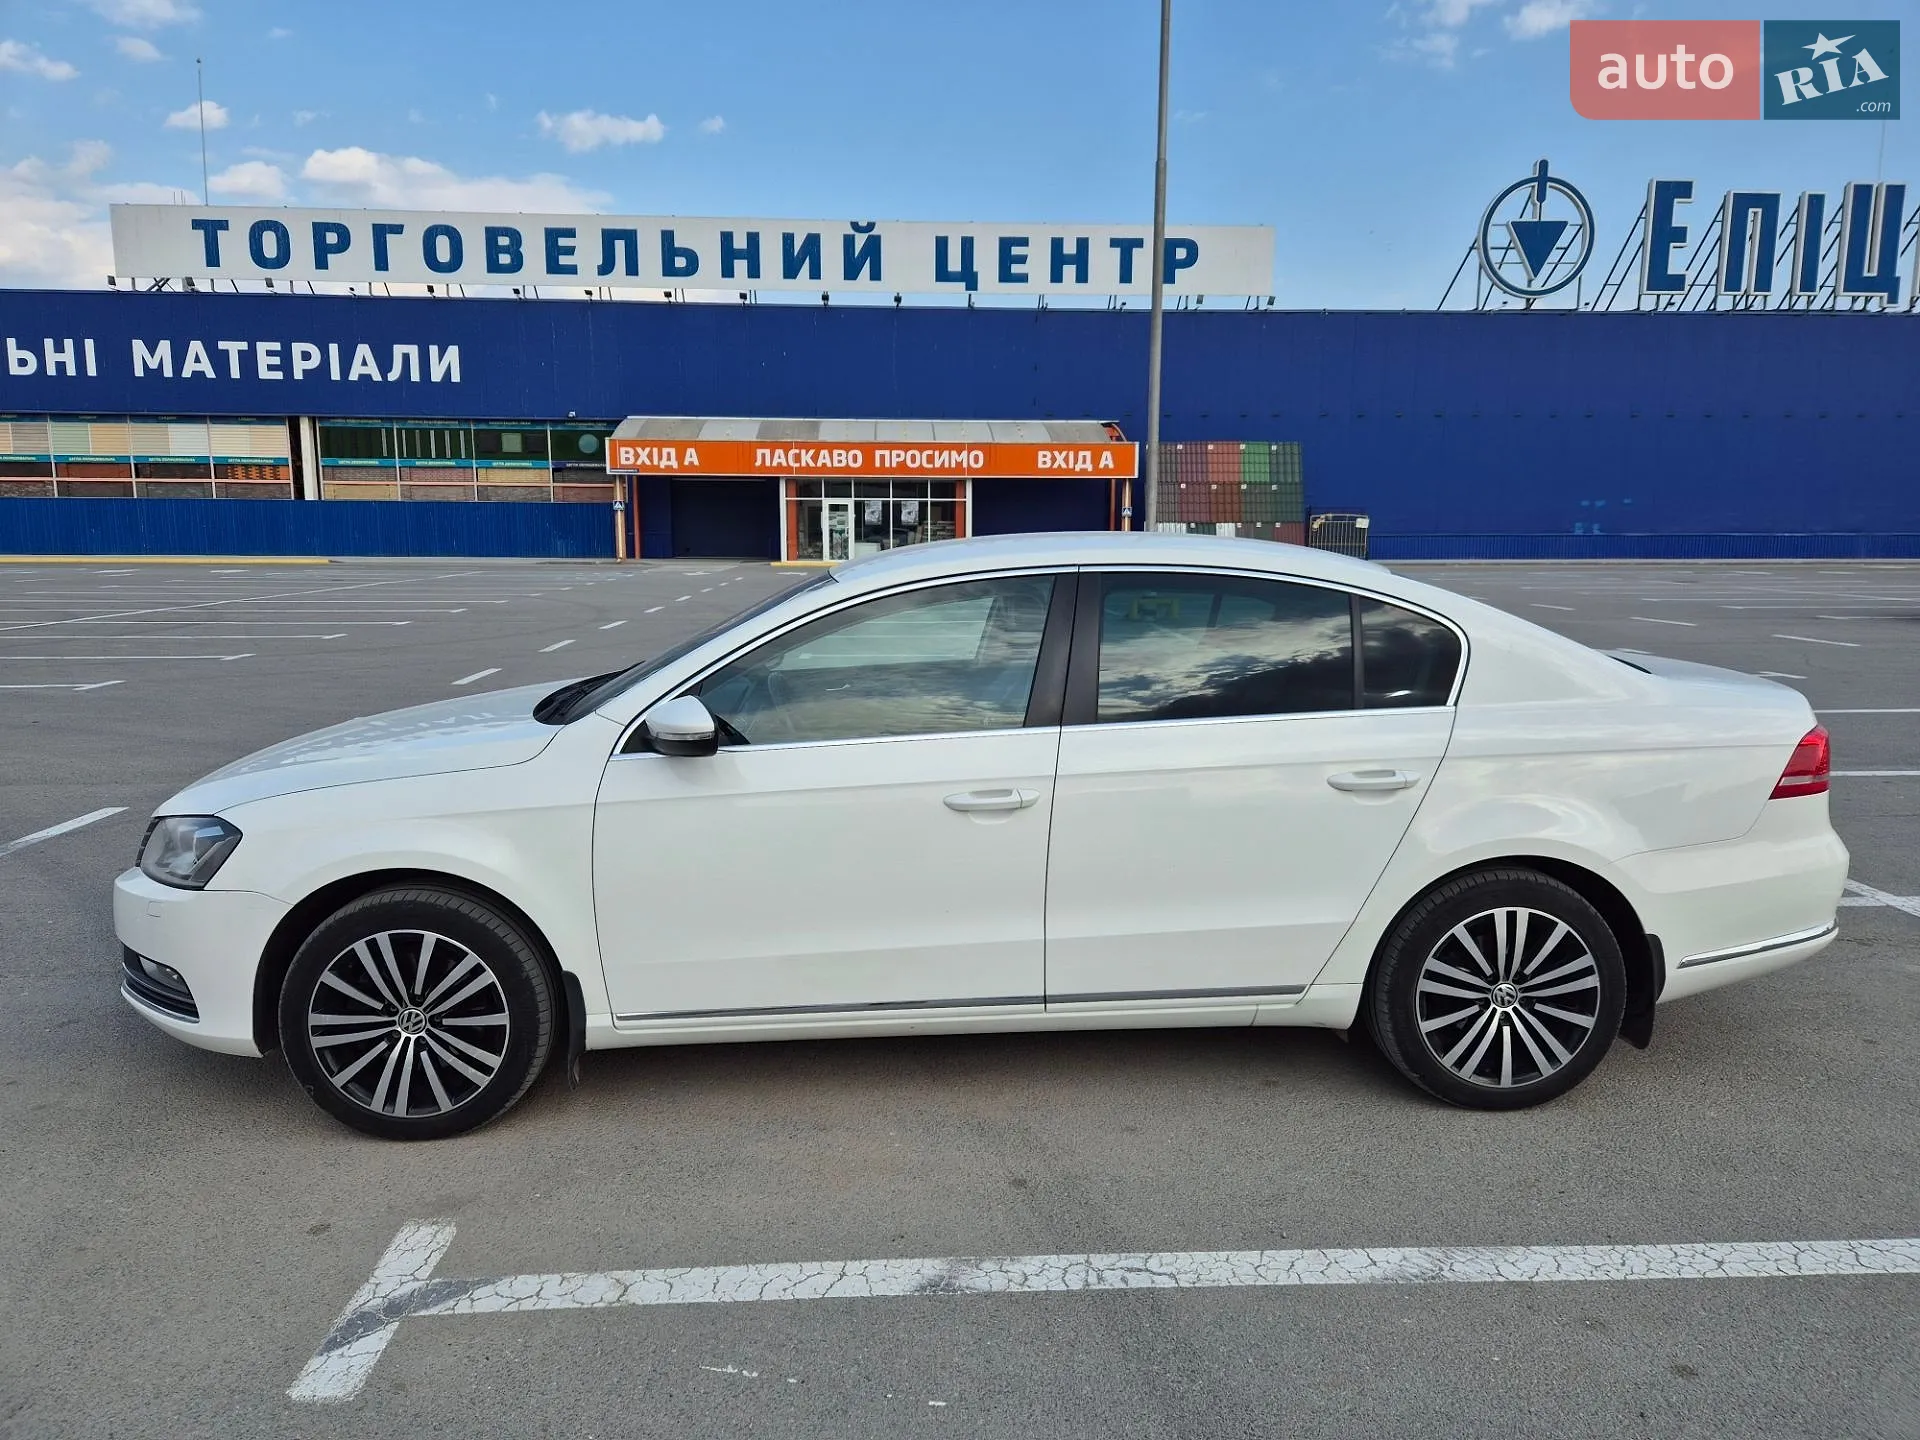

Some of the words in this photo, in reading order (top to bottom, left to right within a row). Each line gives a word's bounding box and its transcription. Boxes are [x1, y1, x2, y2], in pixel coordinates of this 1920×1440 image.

[191, 219, 882, 281] ТОРГОВЕЛЬНИЙ
[935, 235, 1199, 291] ЦЕНТР
[1641, 178, 1920, 308] ЕПІЦ
[6, 337, 98, 378] ЬНІ
[131, 339, 462, 384] МАТЕРІАЛИ
[619, 446, 679, 469] ВХІД
[683, 447, 701, 466] А
[754, 449, 864, 469] ЛАСКАВО
[873, 450, 985, 469] ПРОСИМО
[1036, 451, 1093, 471] ВХІД
[1098, 451, 1115, 469] А
